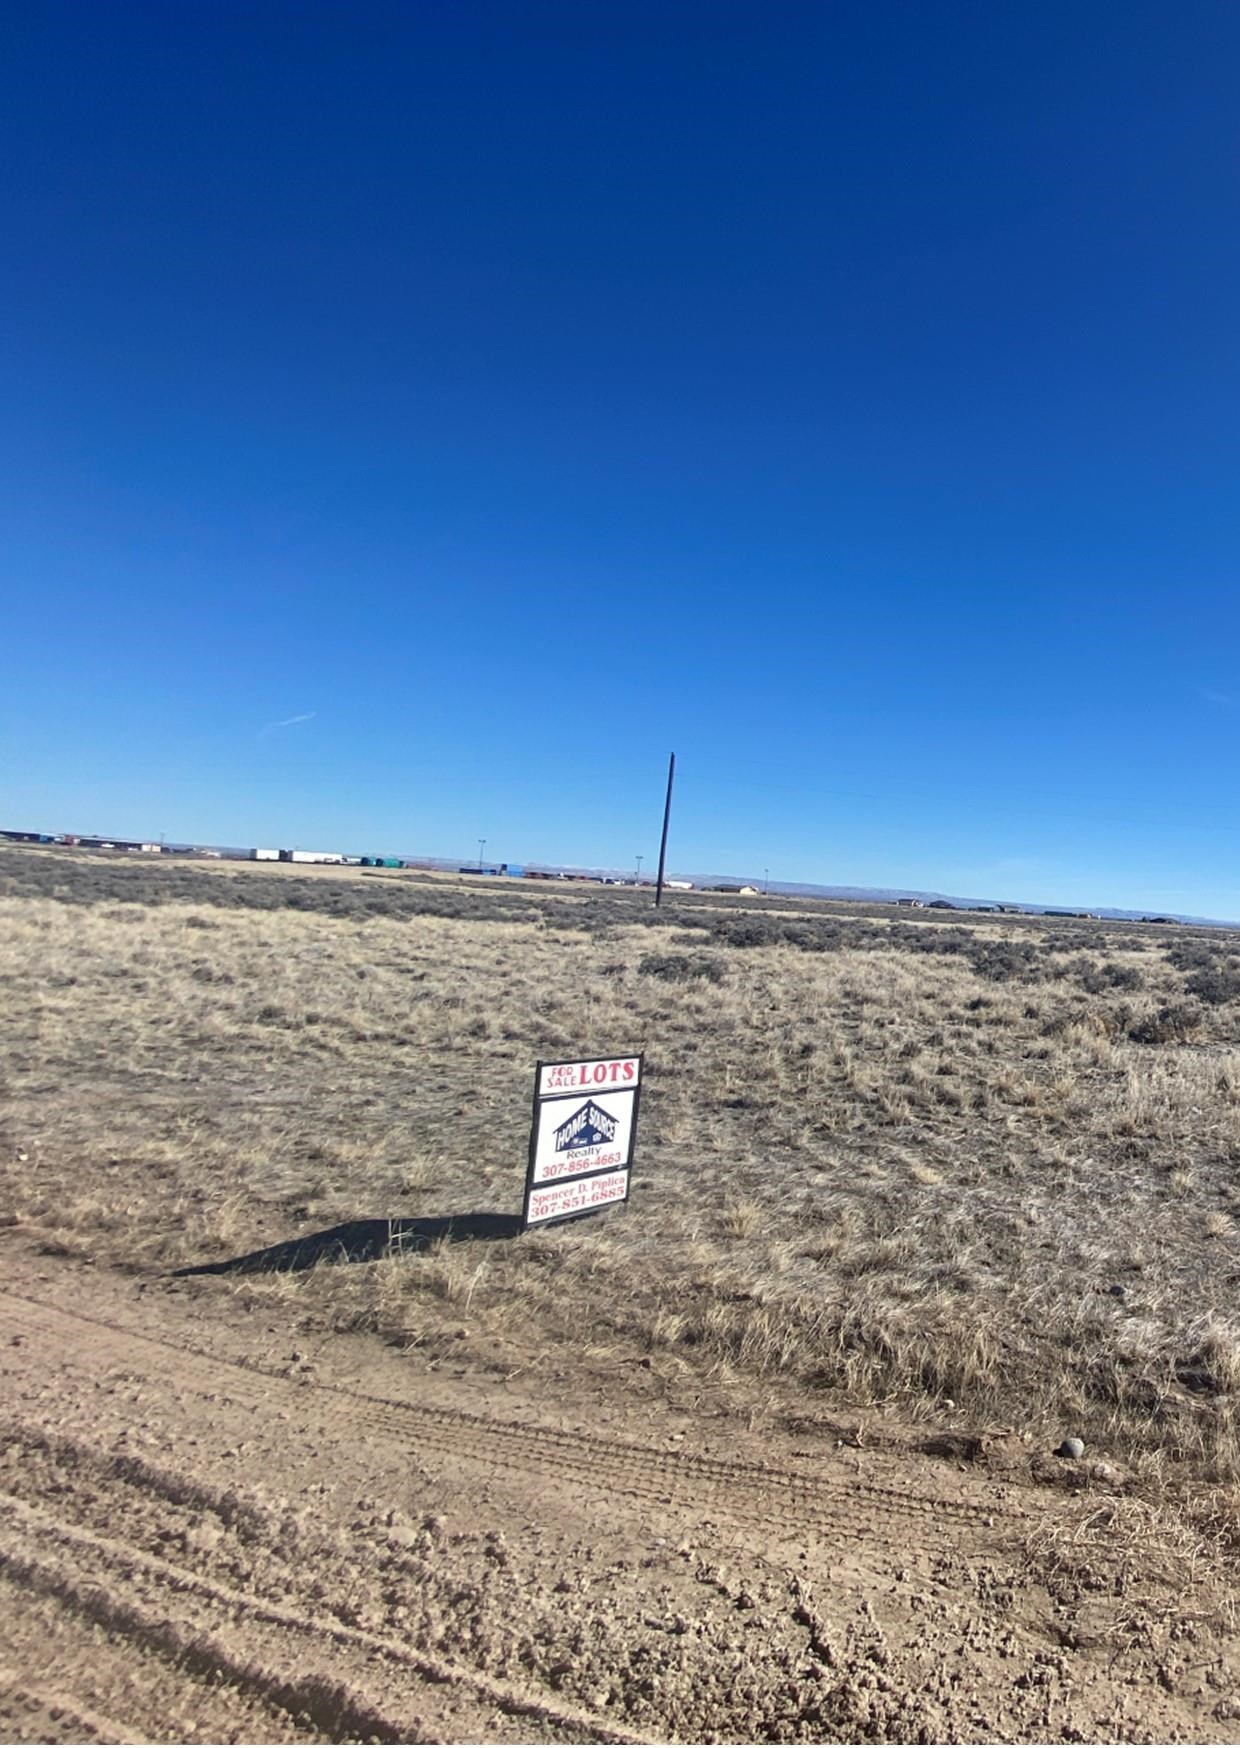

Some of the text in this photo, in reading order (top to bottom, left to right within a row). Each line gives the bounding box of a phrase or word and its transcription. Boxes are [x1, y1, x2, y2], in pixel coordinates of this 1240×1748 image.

[546, 1076, 577, 1088] SALE
[551, 1066, 574, 1077] FOR
[579, 1062, 635, 1085] LOTS
[556, 1108, 589, 1151] HOME
[541, 1152, 622, 1178] 307-856-4663
[566, 1146, 602, 1160] Realty
[531, 1176, 626, 1206] Spencer D. Piplica
[531, 1186, 625, 1218] 307-851-6885
